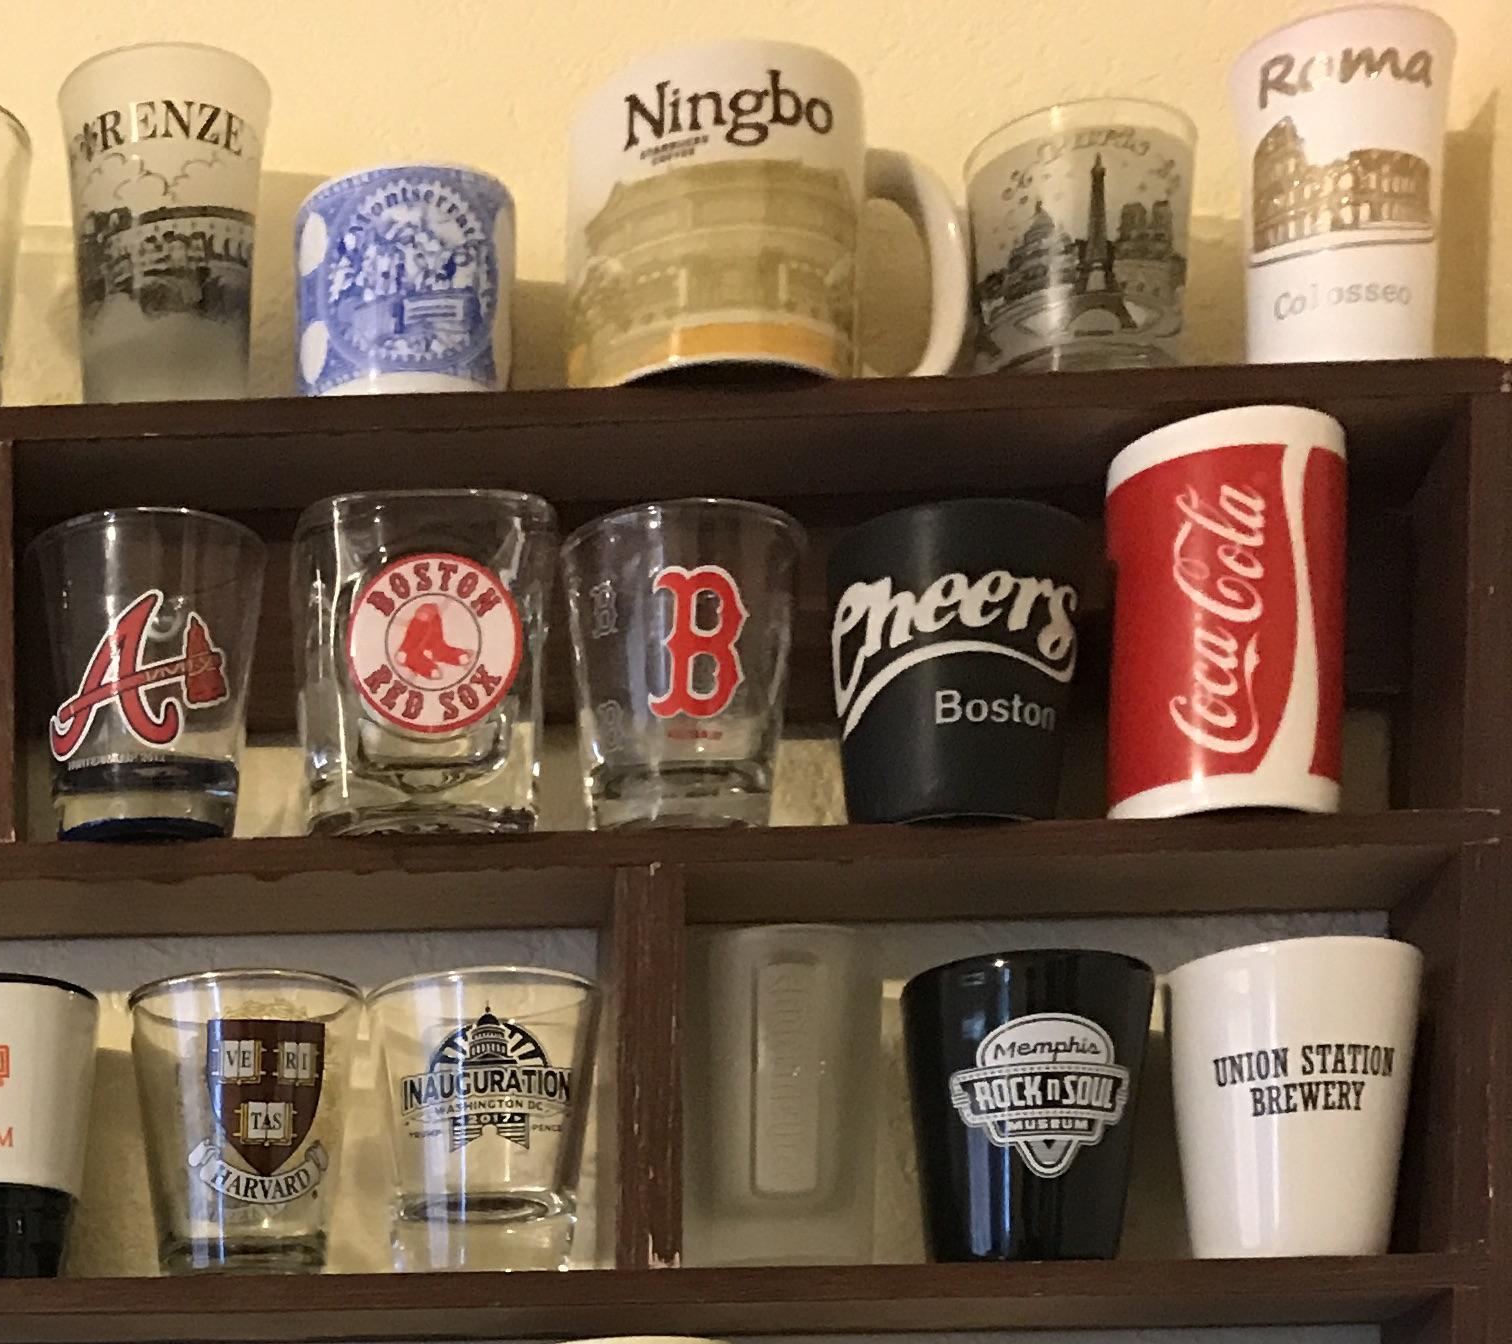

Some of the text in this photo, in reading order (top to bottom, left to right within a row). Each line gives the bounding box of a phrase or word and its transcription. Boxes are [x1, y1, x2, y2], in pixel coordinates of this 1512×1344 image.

[623, 69, 834, 147] Ningbo
[367, 561, 502, 617] BOSTON
[648, 565, 751, 719] B
[832, 569, 1078, 720] Cheers
[364, 664, 503, 721] RED SOX
[934, 688, 1056, 732] Boston
[224, 1046, 308, 1073] VE RI
[993, 1036, 1101, 1062] Memphis
[1213, 1042, 1397, 1089] UNION STATION
[402, 1067, 572, 1112] INAUGURATION
[434, 1099, 522, 1115] WASHINGTON
[973, 1075, 1043, 1111] ROCK
[1062, 1075, 1114, 1109] SOUL
[1250, 1079, 1366, 1118] BREWERY
[249, 1110, 283, 1131] TAS
[466, 1113, 513, 1126] 2017
[531, 1122, 564, 1135] PENCE
[1008, 1118, 1089, 1131] MUSEUM
[210, 1165, 312, 1200] HARVARD
